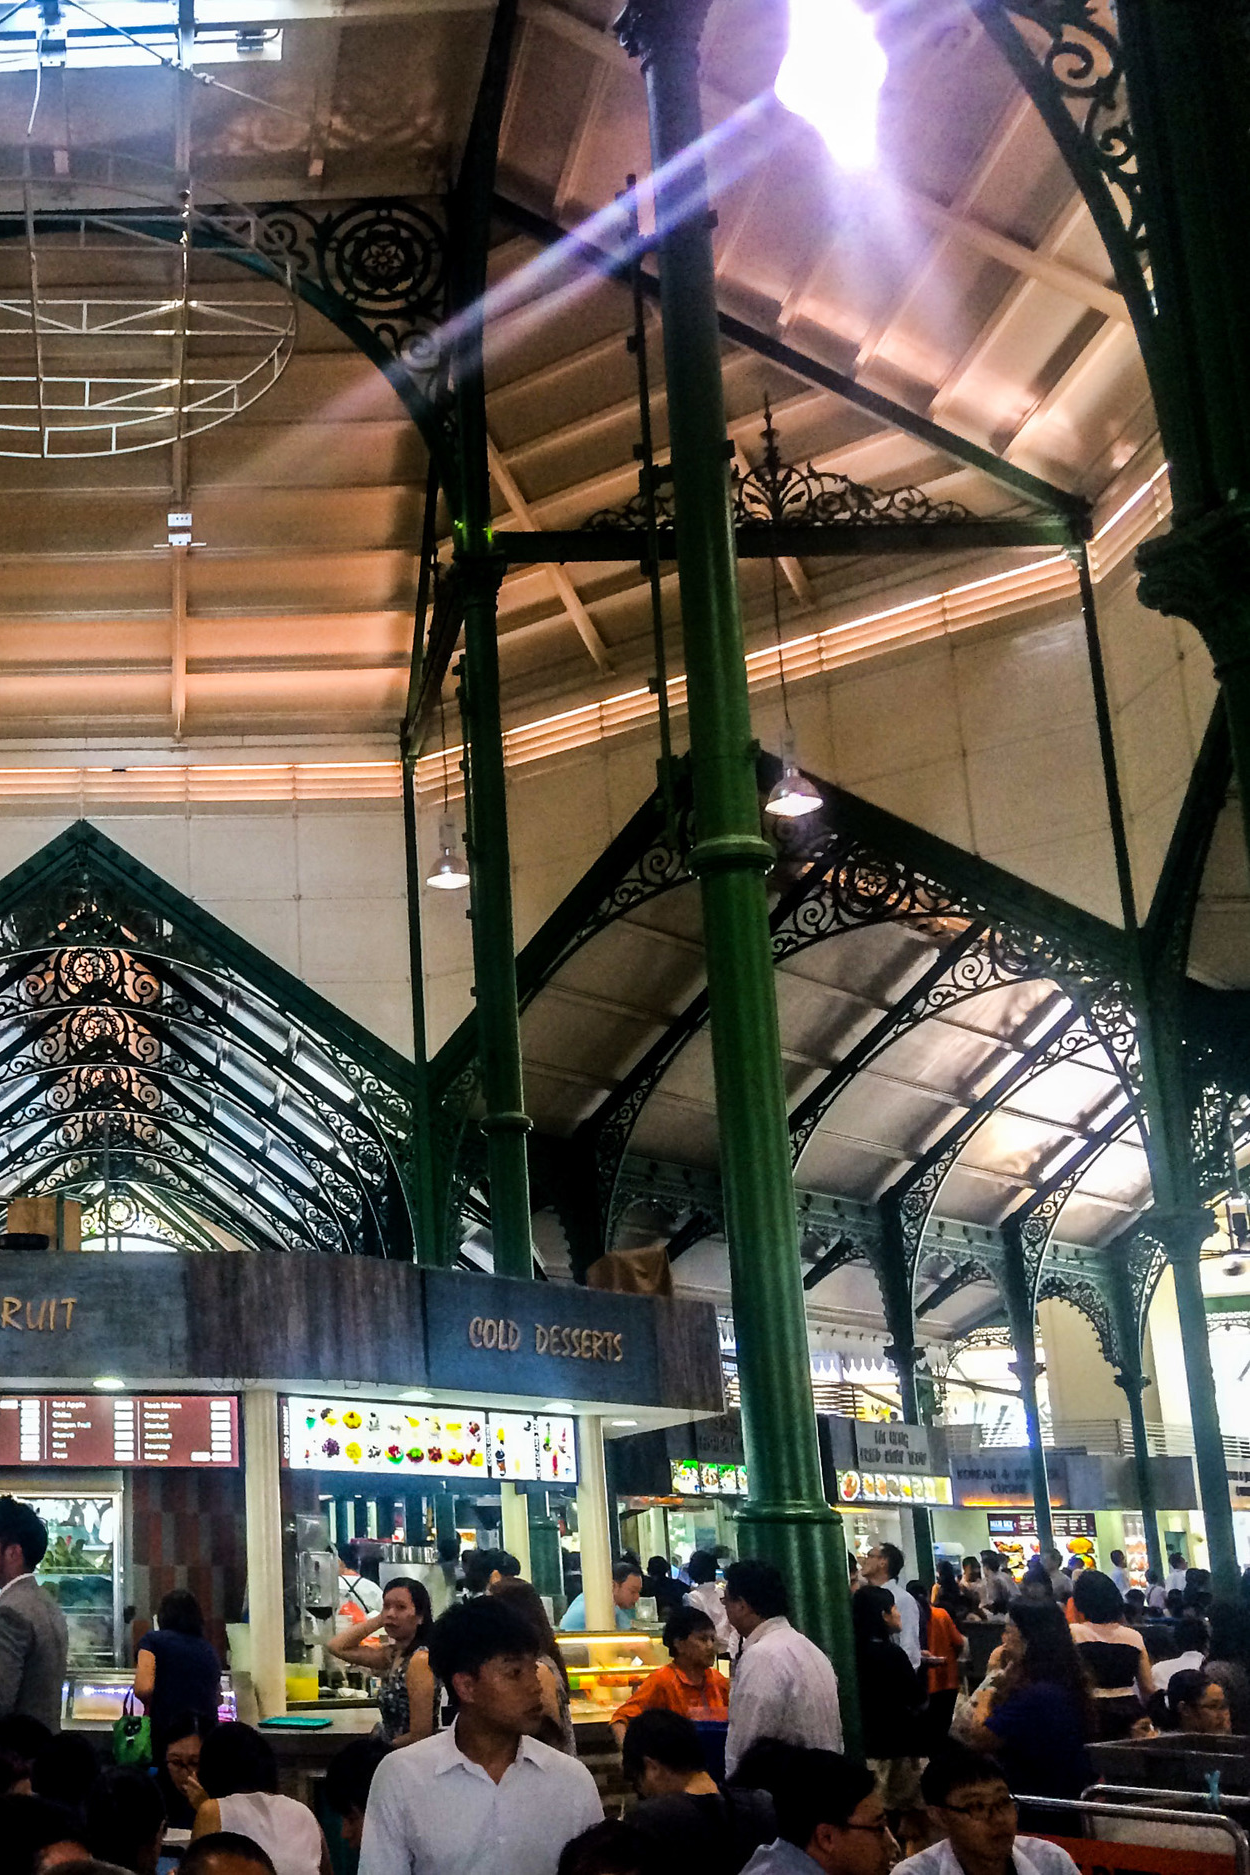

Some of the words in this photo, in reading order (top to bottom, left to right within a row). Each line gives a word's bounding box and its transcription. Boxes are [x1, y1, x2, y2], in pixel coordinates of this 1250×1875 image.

[469, 1316, 521, 1351] COLD
[535, 1323, 623, 1362] DESSERTS
[956, 1468, 997, 1480] KOREAN
